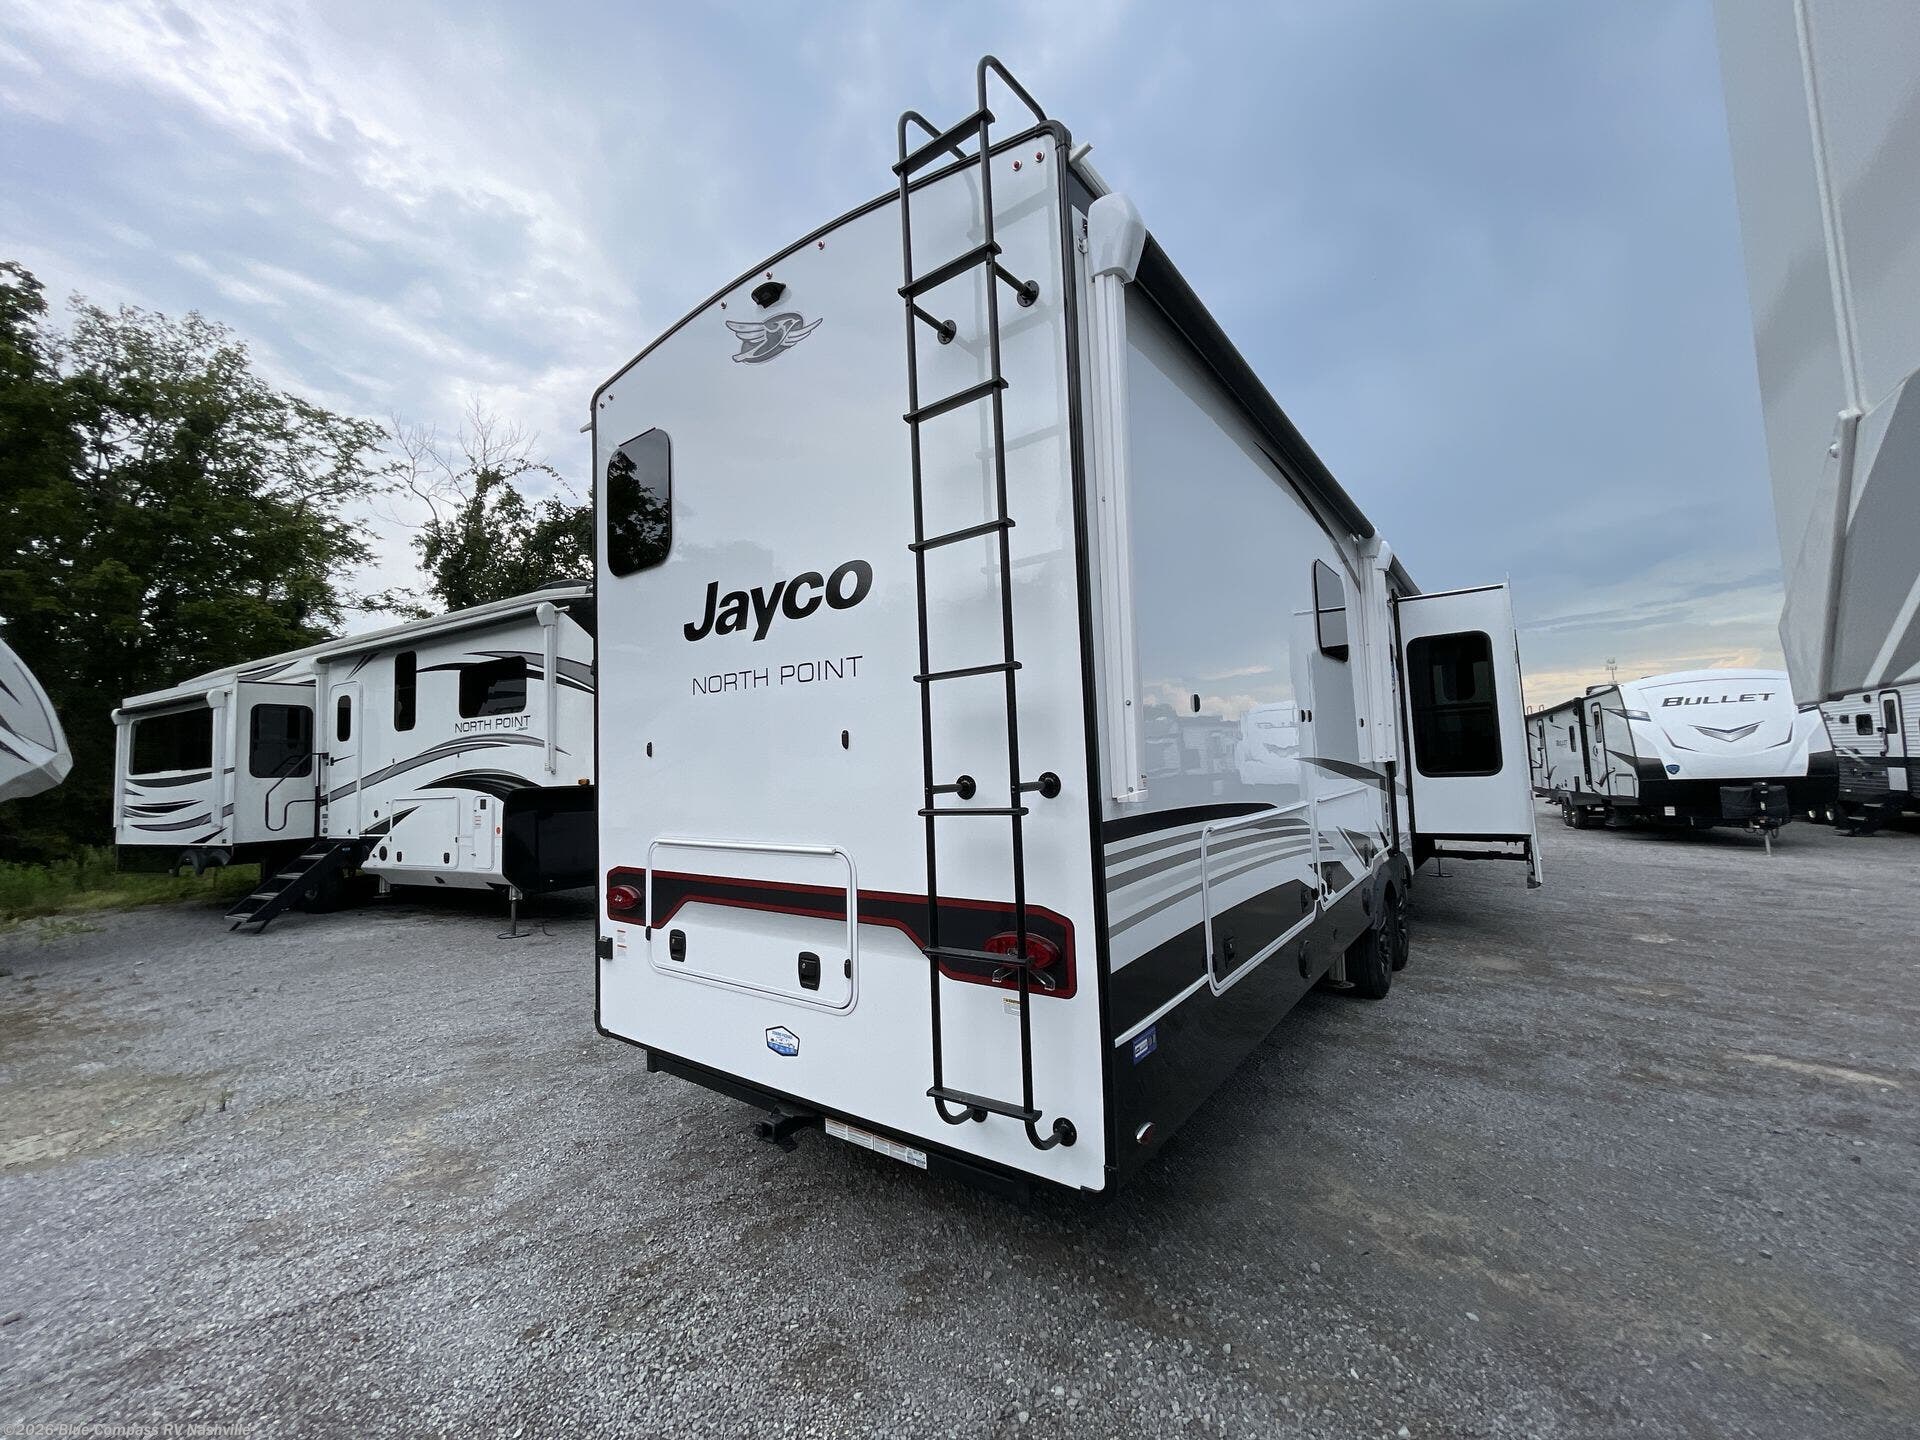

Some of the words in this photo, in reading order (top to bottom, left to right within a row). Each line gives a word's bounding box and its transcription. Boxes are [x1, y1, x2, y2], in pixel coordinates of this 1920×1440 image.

[684, 559, 873, 642] Jayco
[692, 668, 769, 696] NORTH
[780, 656, 863, 685] POINT
[1662, 693, 1775, 707] BULLET
[454, 720, 492, 733] NORTH
[495, 715, 531, 729] POINT
